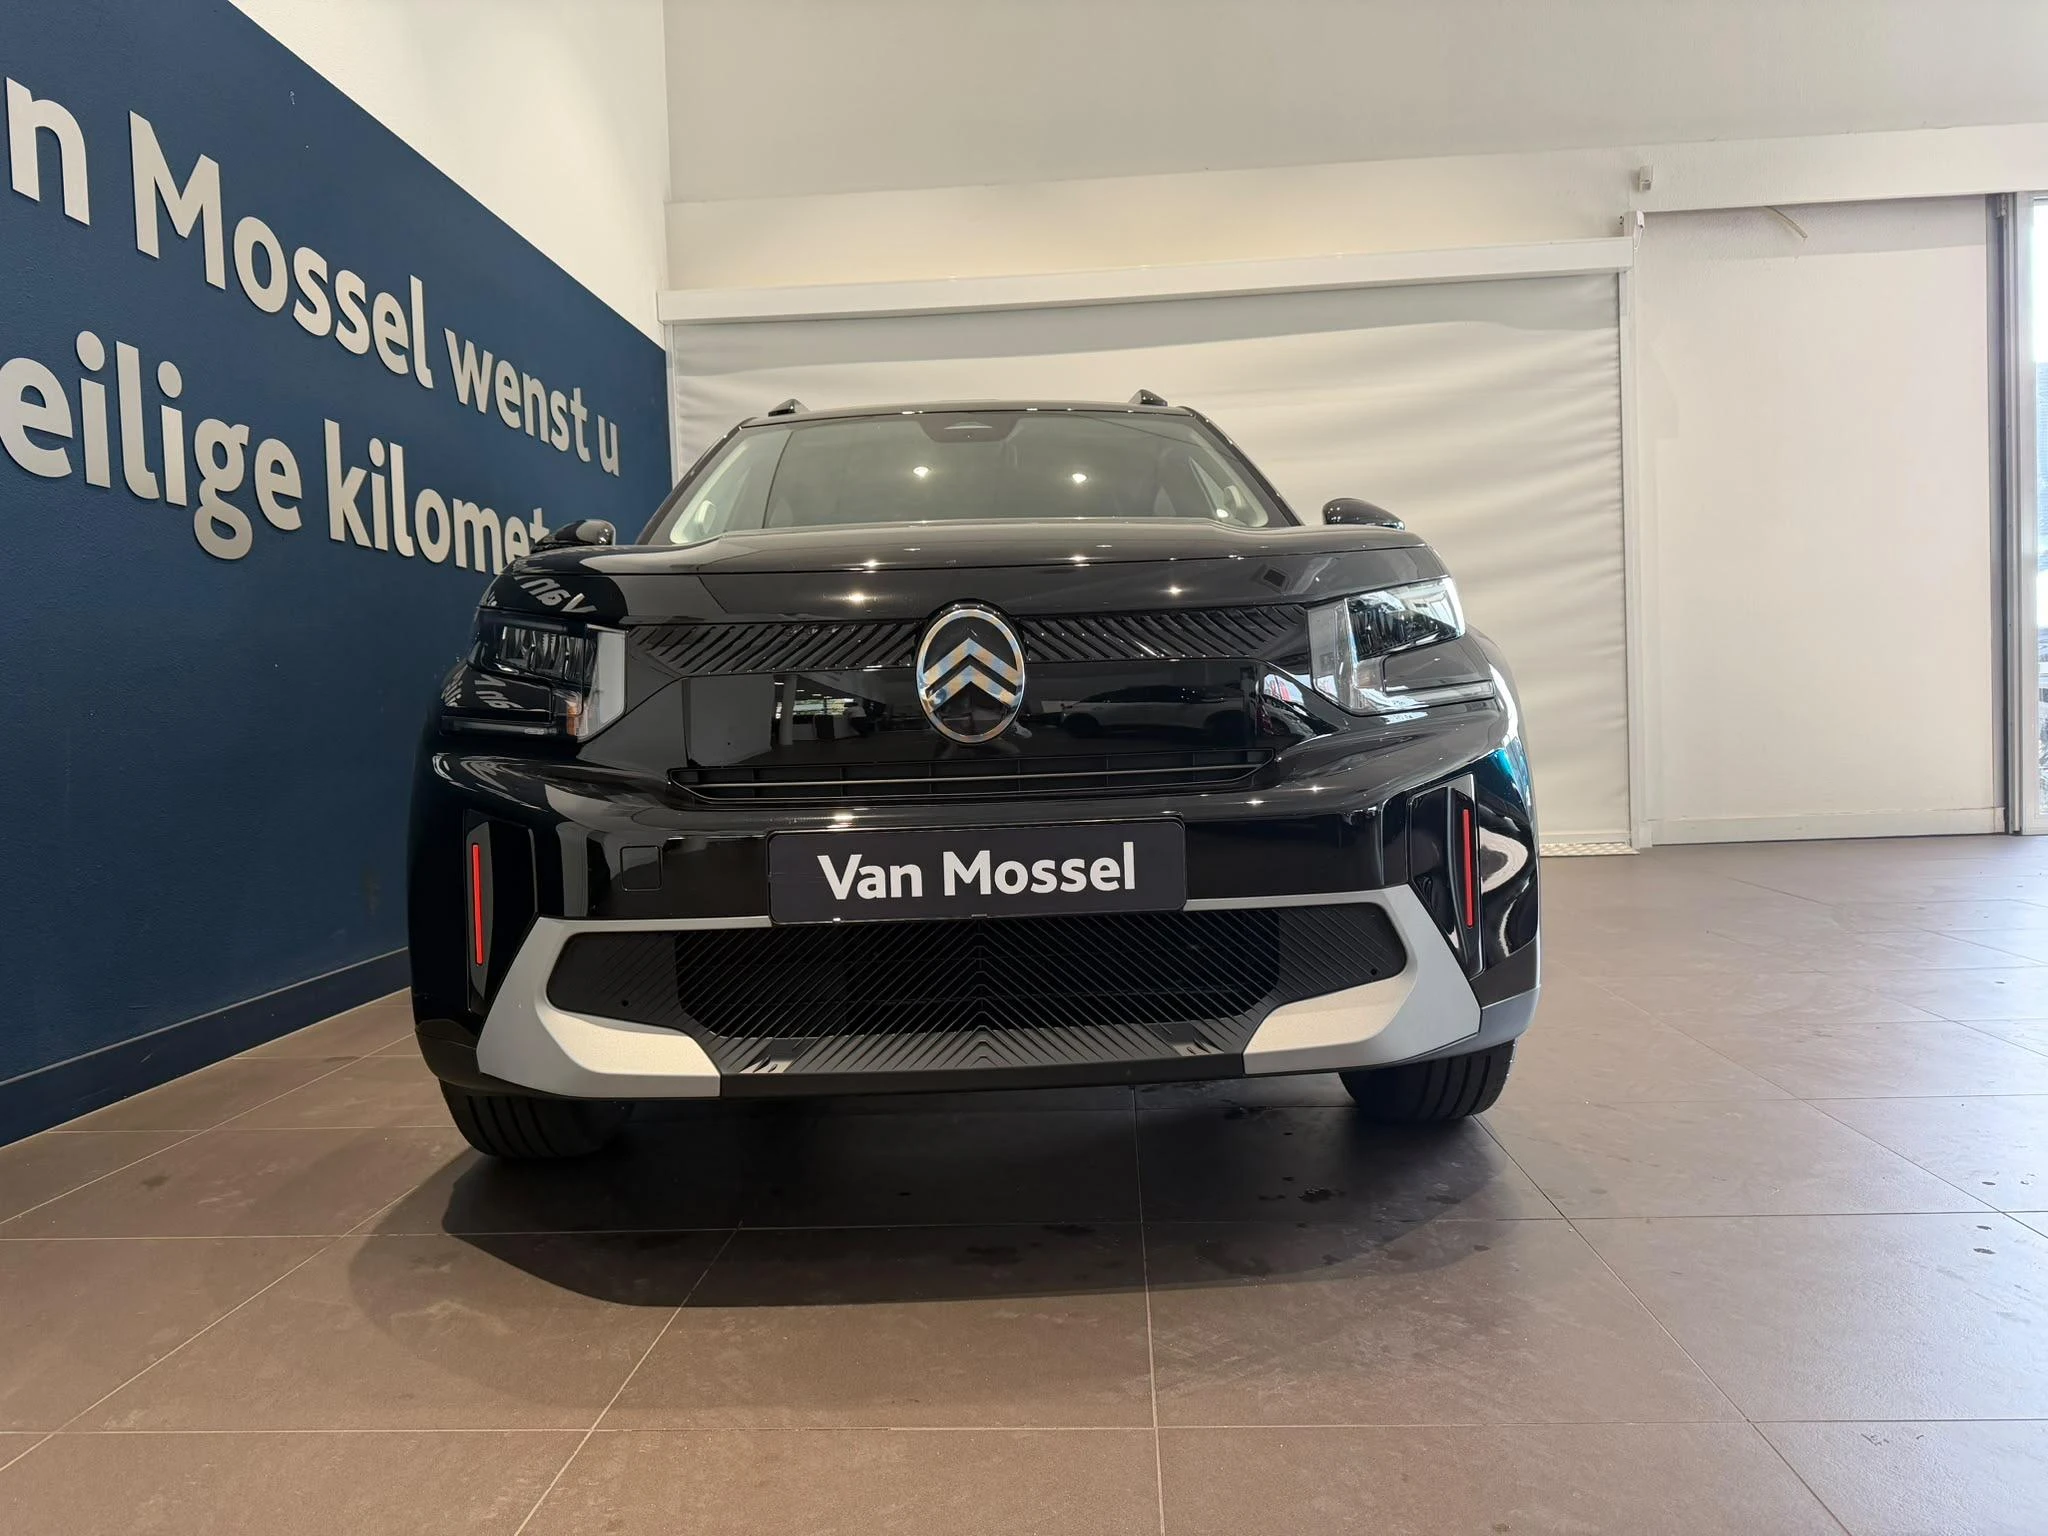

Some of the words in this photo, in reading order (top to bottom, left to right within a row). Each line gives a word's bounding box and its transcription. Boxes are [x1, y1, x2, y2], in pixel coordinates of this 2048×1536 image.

[129, 110, 434, 389] Mossel
[444, 327, 591, 462] wenst
[597, 415, 620, 477] u
[0, 330, 303, 560] eilige
[816, 853, 923, 900] Van
[942, 841, 1136, 895] Mossel
